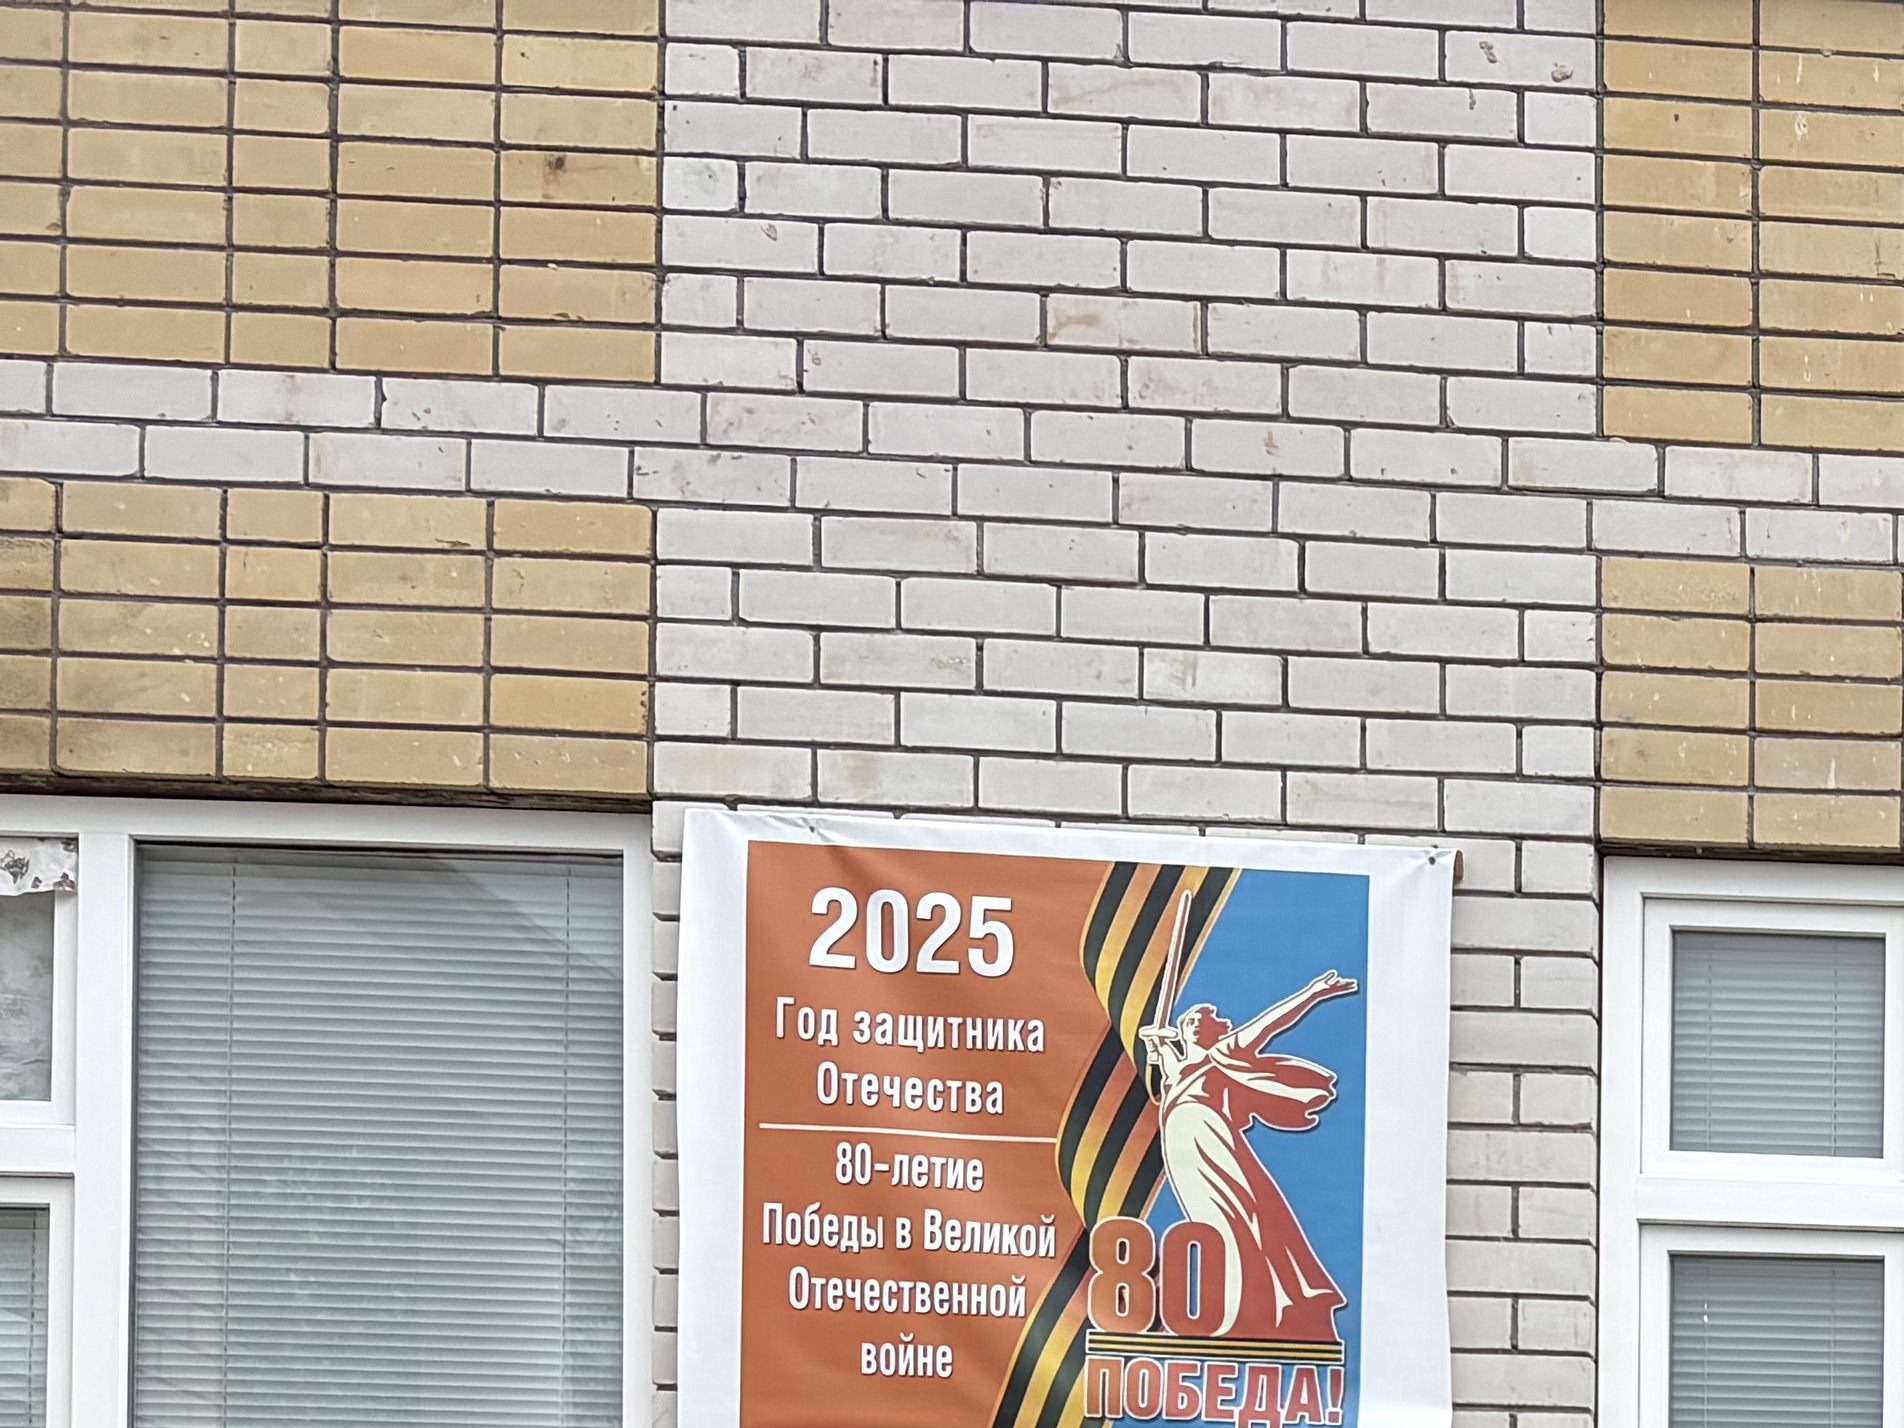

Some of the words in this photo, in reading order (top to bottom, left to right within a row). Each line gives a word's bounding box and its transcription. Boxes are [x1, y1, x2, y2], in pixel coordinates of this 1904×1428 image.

[808, 887, 1015, 977] 2025
[774, 996, 839, 1047] Год
[853, 1009, 1045, 1053] защитника
[816, 1061, 1005, 1115] Отечества
[834, 1142, 984, 1191] 80-летие
[762, 1202, 885, 1253] Победы
[895, 1220, 912, 1250] в
[922, 1209, 1056, 1259] Великой
[788, 1267, 1027, 1318] Отечественной
[1087, 1216, 1231, 1336] 80
[860, 1333, 954, 1380] войне
